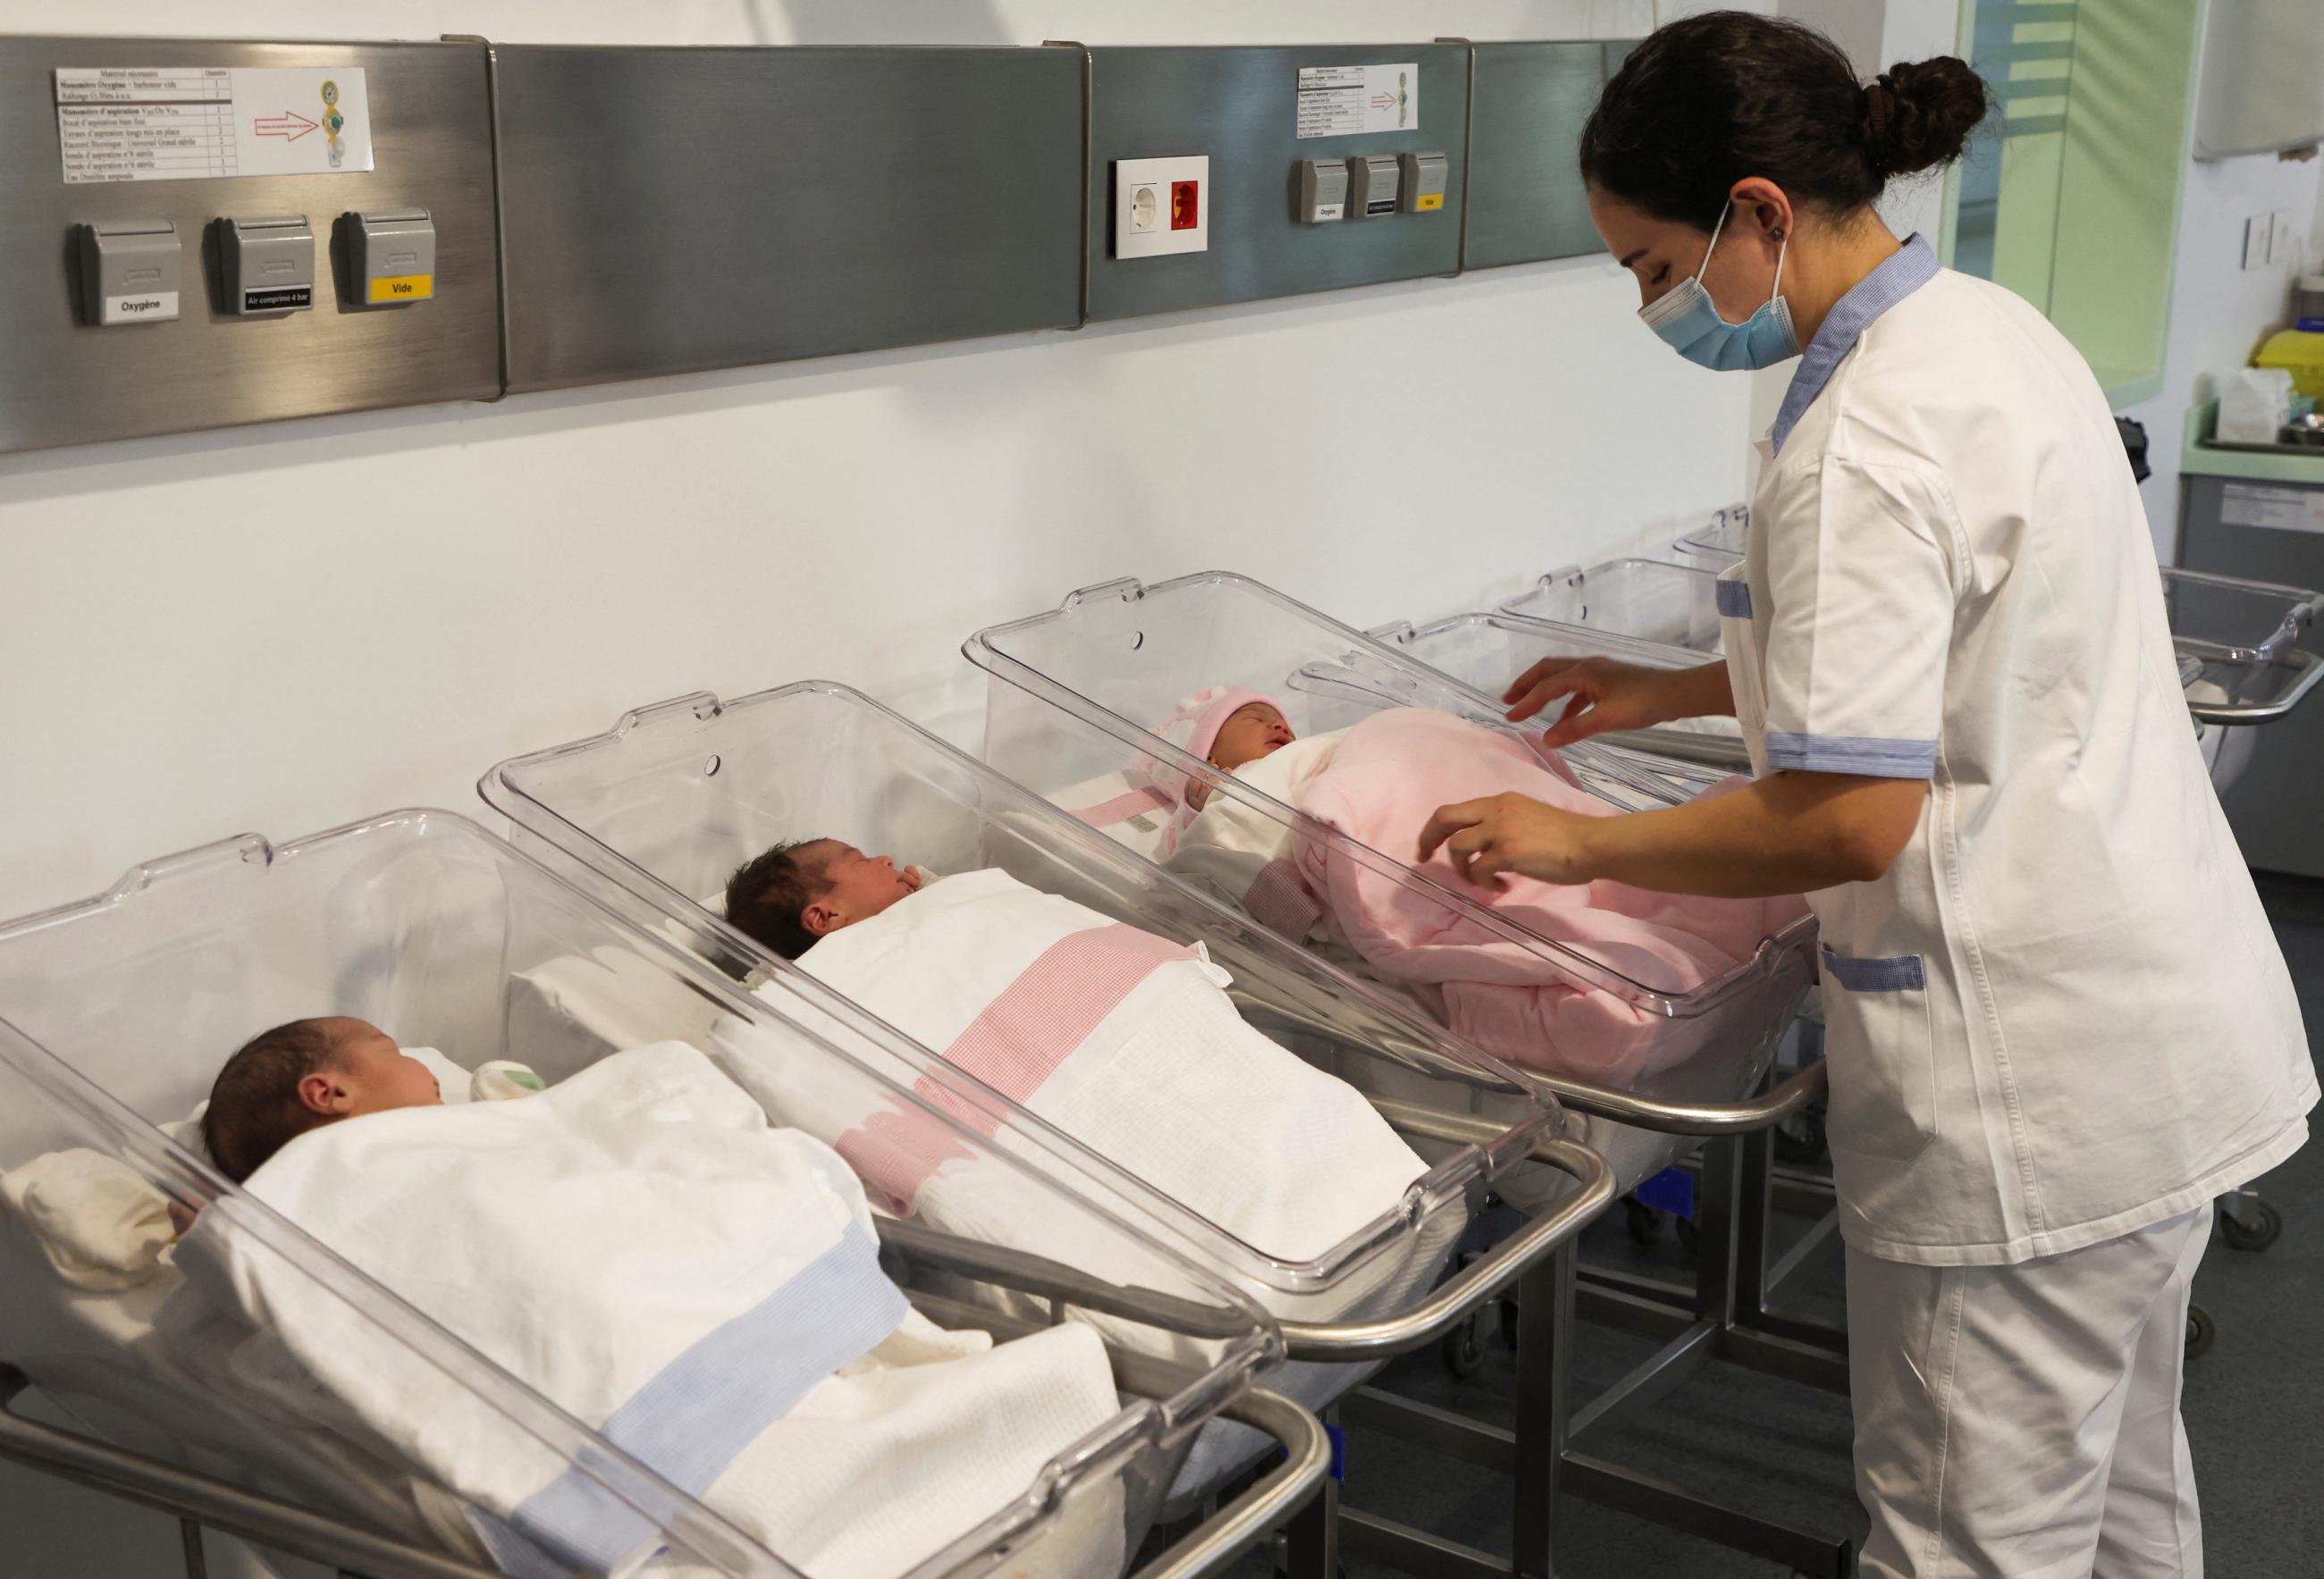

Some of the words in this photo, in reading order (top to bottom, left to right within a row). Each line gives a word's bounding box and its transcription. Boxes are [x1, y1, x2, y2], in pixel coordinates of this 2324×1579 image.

[392, 283, 413, 294] Vide
[248, 297, 258, 305] Air
[259, 294, 290, 305] comprimé
[297, 293, 308, 301] bar
[121, 300, 161, 313] Oxygène
